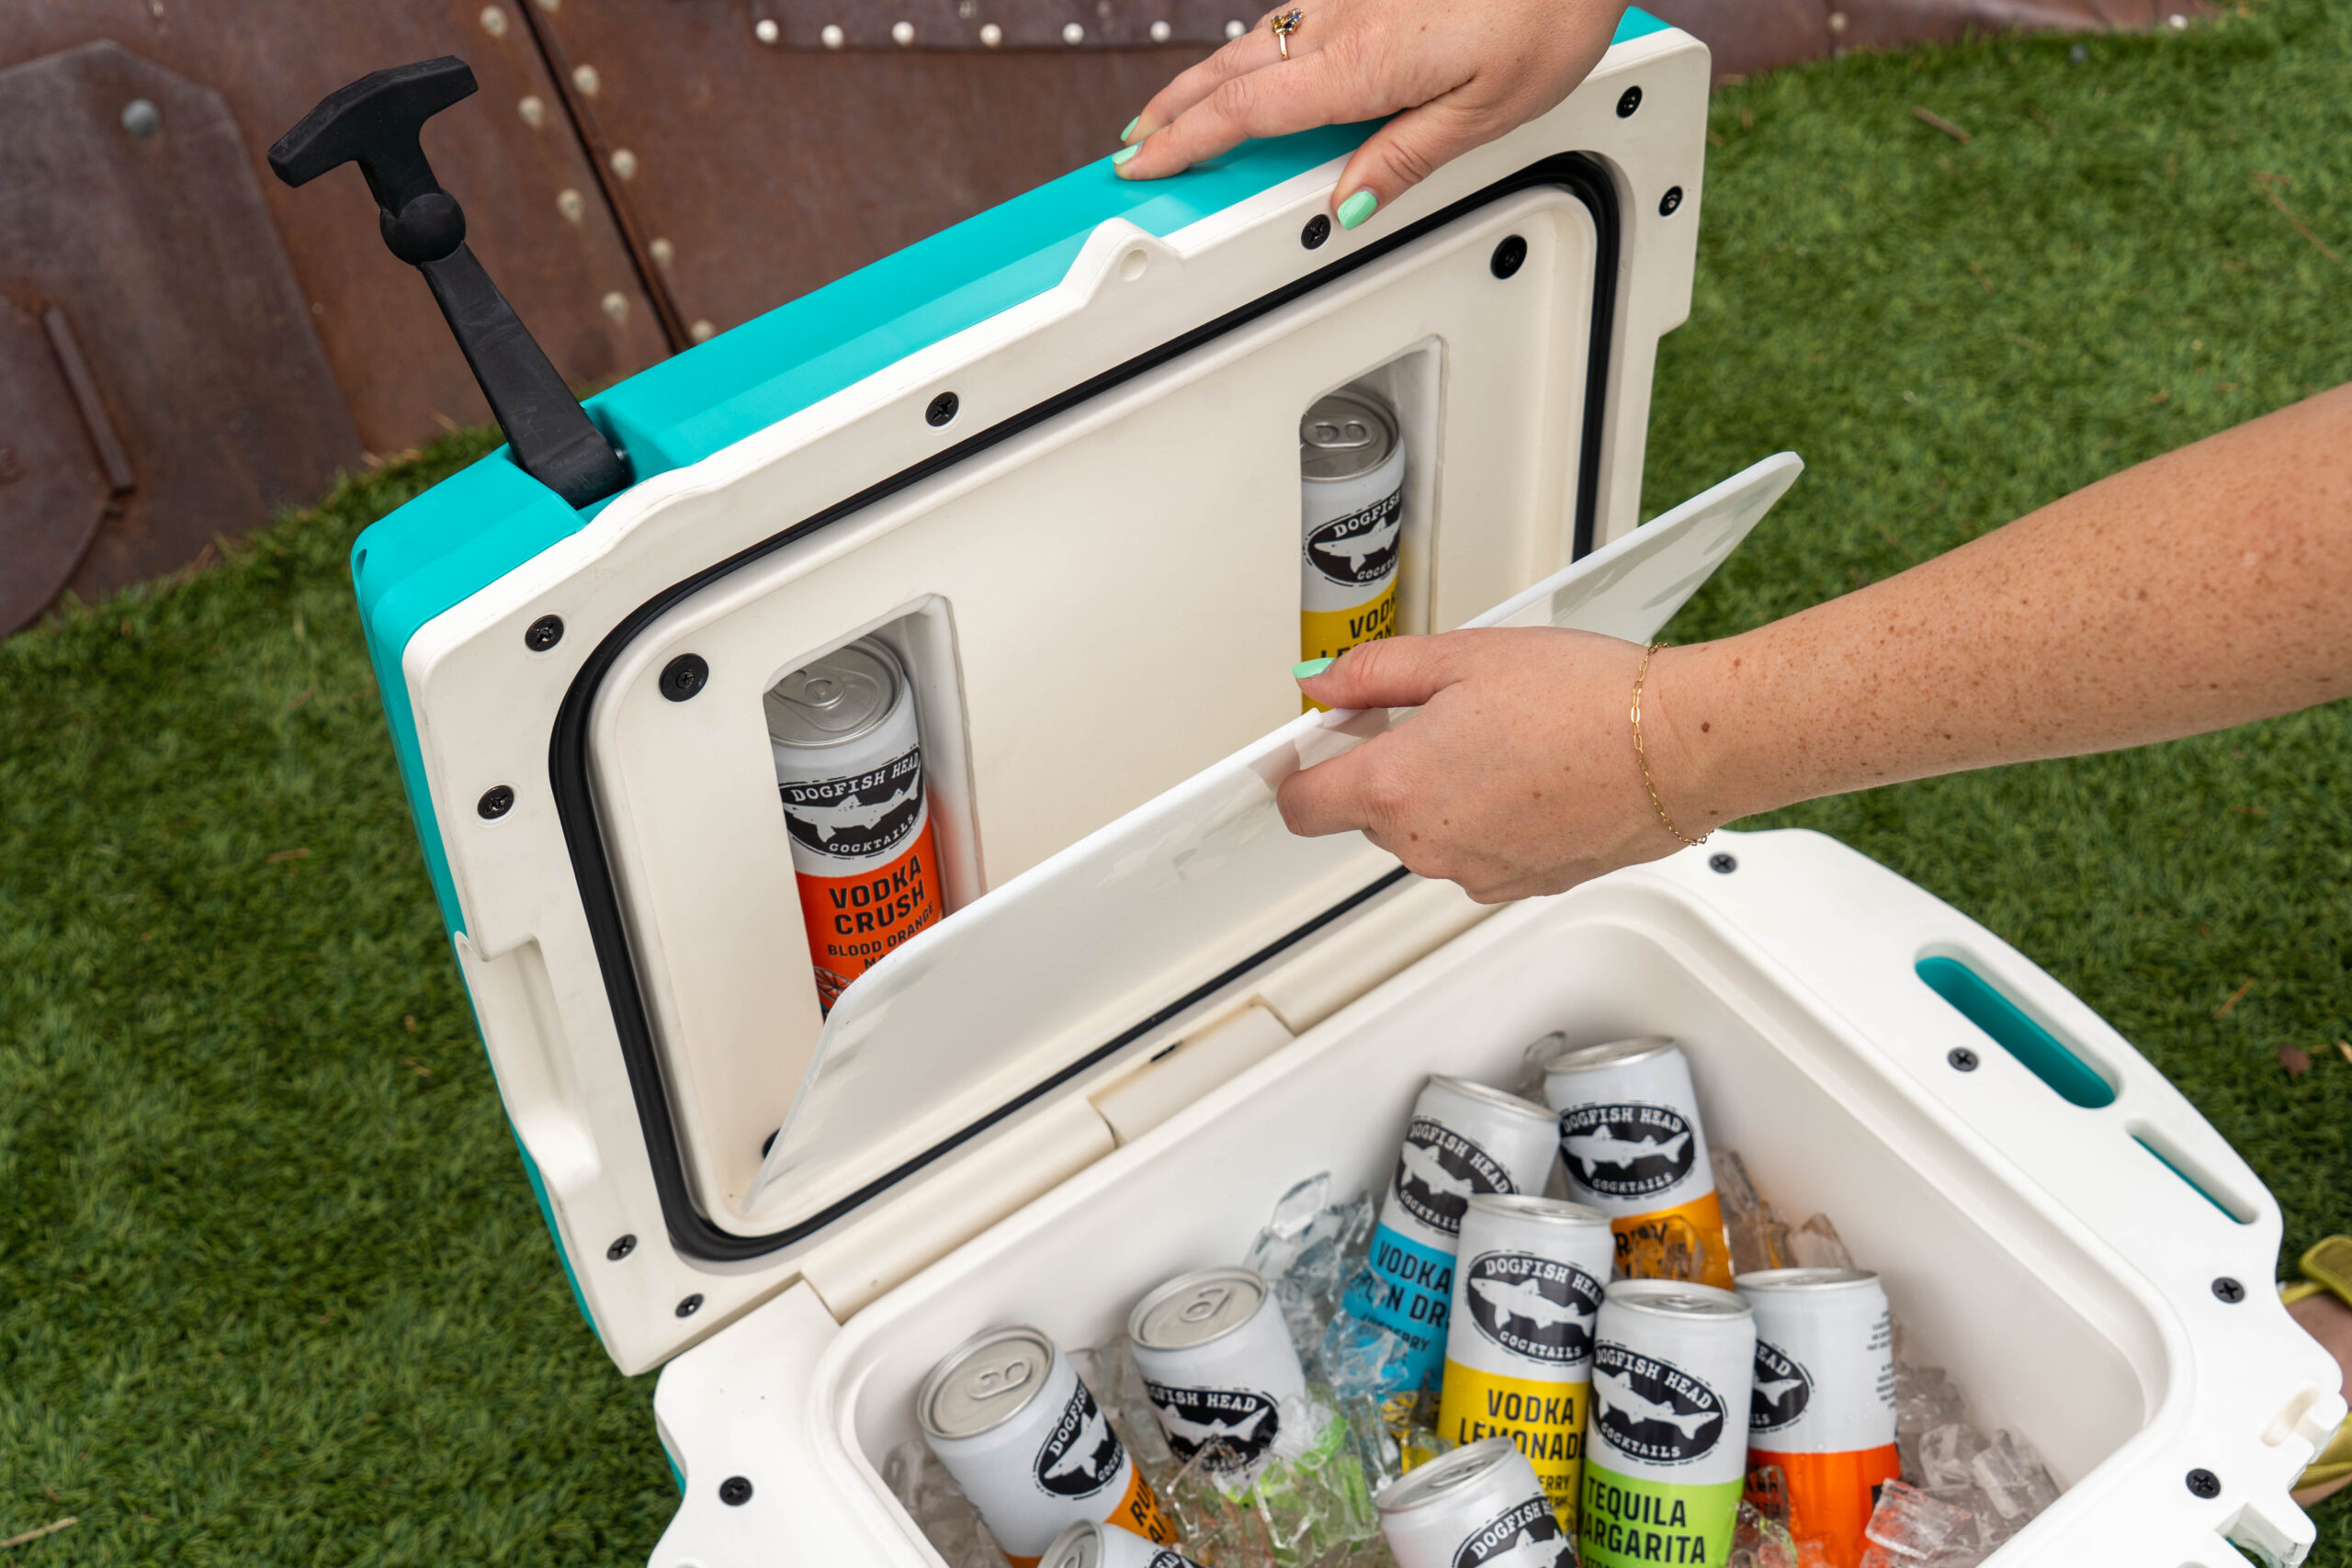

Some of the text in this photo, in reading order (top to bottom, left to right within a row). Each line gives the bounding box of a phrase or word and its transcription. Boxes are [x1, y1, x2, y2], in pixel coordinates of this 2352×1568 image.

[791, 770, 887, 802] DOGFISH
[829, 814, 914, 853] COCKTAILS
[829, 854, 922, 908] VODKA
[834, 879, 924, 935] CRUSH
[828, 900, 933, 957] BLOOD ORANGE
[1640, 1109, 1682, 1133] HEAD
[1469, 1152, 1510, 1193] HEAD
[1592, 1171, 1674, 1193] COCKTAILS
[1377, 1240, 1452, 1295] VODKA
[1485, 1258, 1569, 1284] DOGFISH
[1408, 1292, 1450, 1329] DR
[1499, 1330, 1582, 1359] COCKTAILS
[1756, 1344, 1792, 1378] EAD
[1206, 1394, 1258, 1413] HEAD
[1487, 1388, 1574, 1425] VODKA
[1664, 1371, 1713, 1409] HEAD
[1600, 1422, 1680, 1458] COCKTAILS
[1589, 1476, 1686, 1529] TEQUILA
[1471, 1501, 1542, 1560] DOGFISH
[1579, 1508, 1705, 1564] ARGARITA
